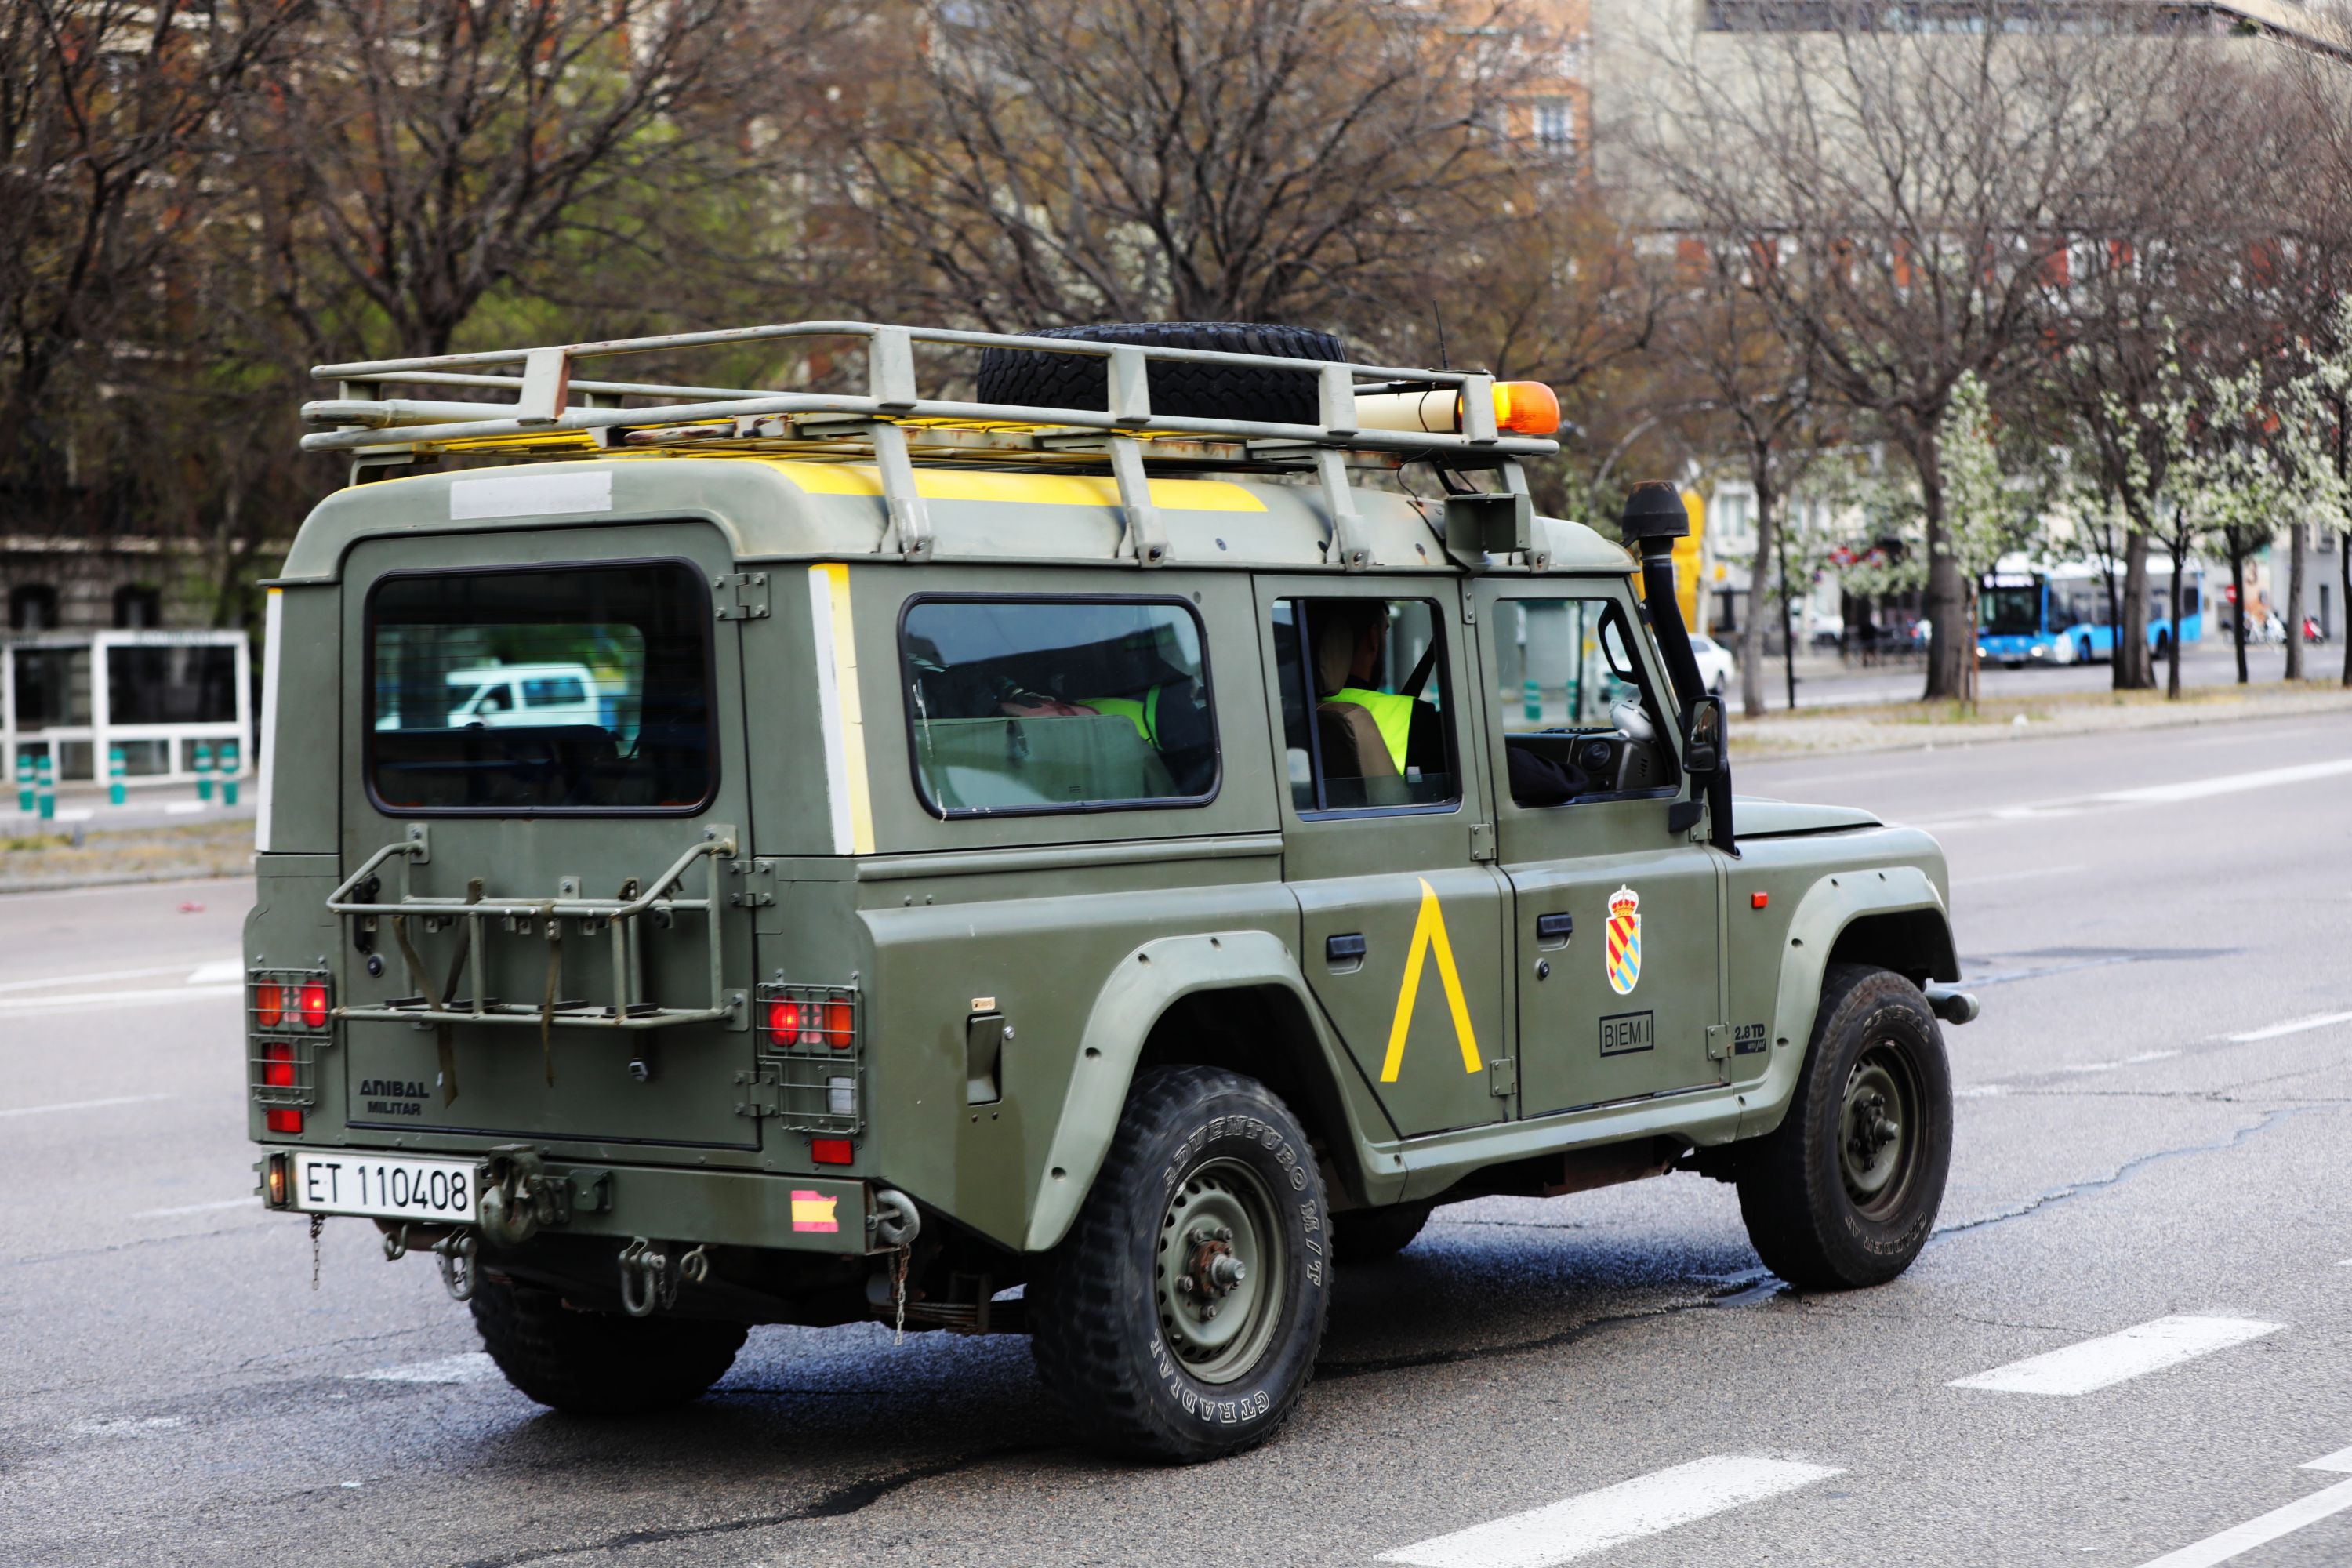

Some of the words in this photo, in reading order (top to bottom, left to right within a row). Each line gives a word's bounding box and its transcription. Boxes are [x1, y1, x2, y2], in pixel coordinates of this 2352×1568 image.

[1605, 1021, 1641, 1048] BIEM
[1734, 1025, 1751, 1040] 2.8
[1751, 1023, 1766, 1038] TD
[359, 1080, 430, 1098] ANIBAL
[367, 1101, 422, 1116] MILITAR
[307, 1162, 342, 1203] ET
[358, 1165, 468, 1212] 110408
